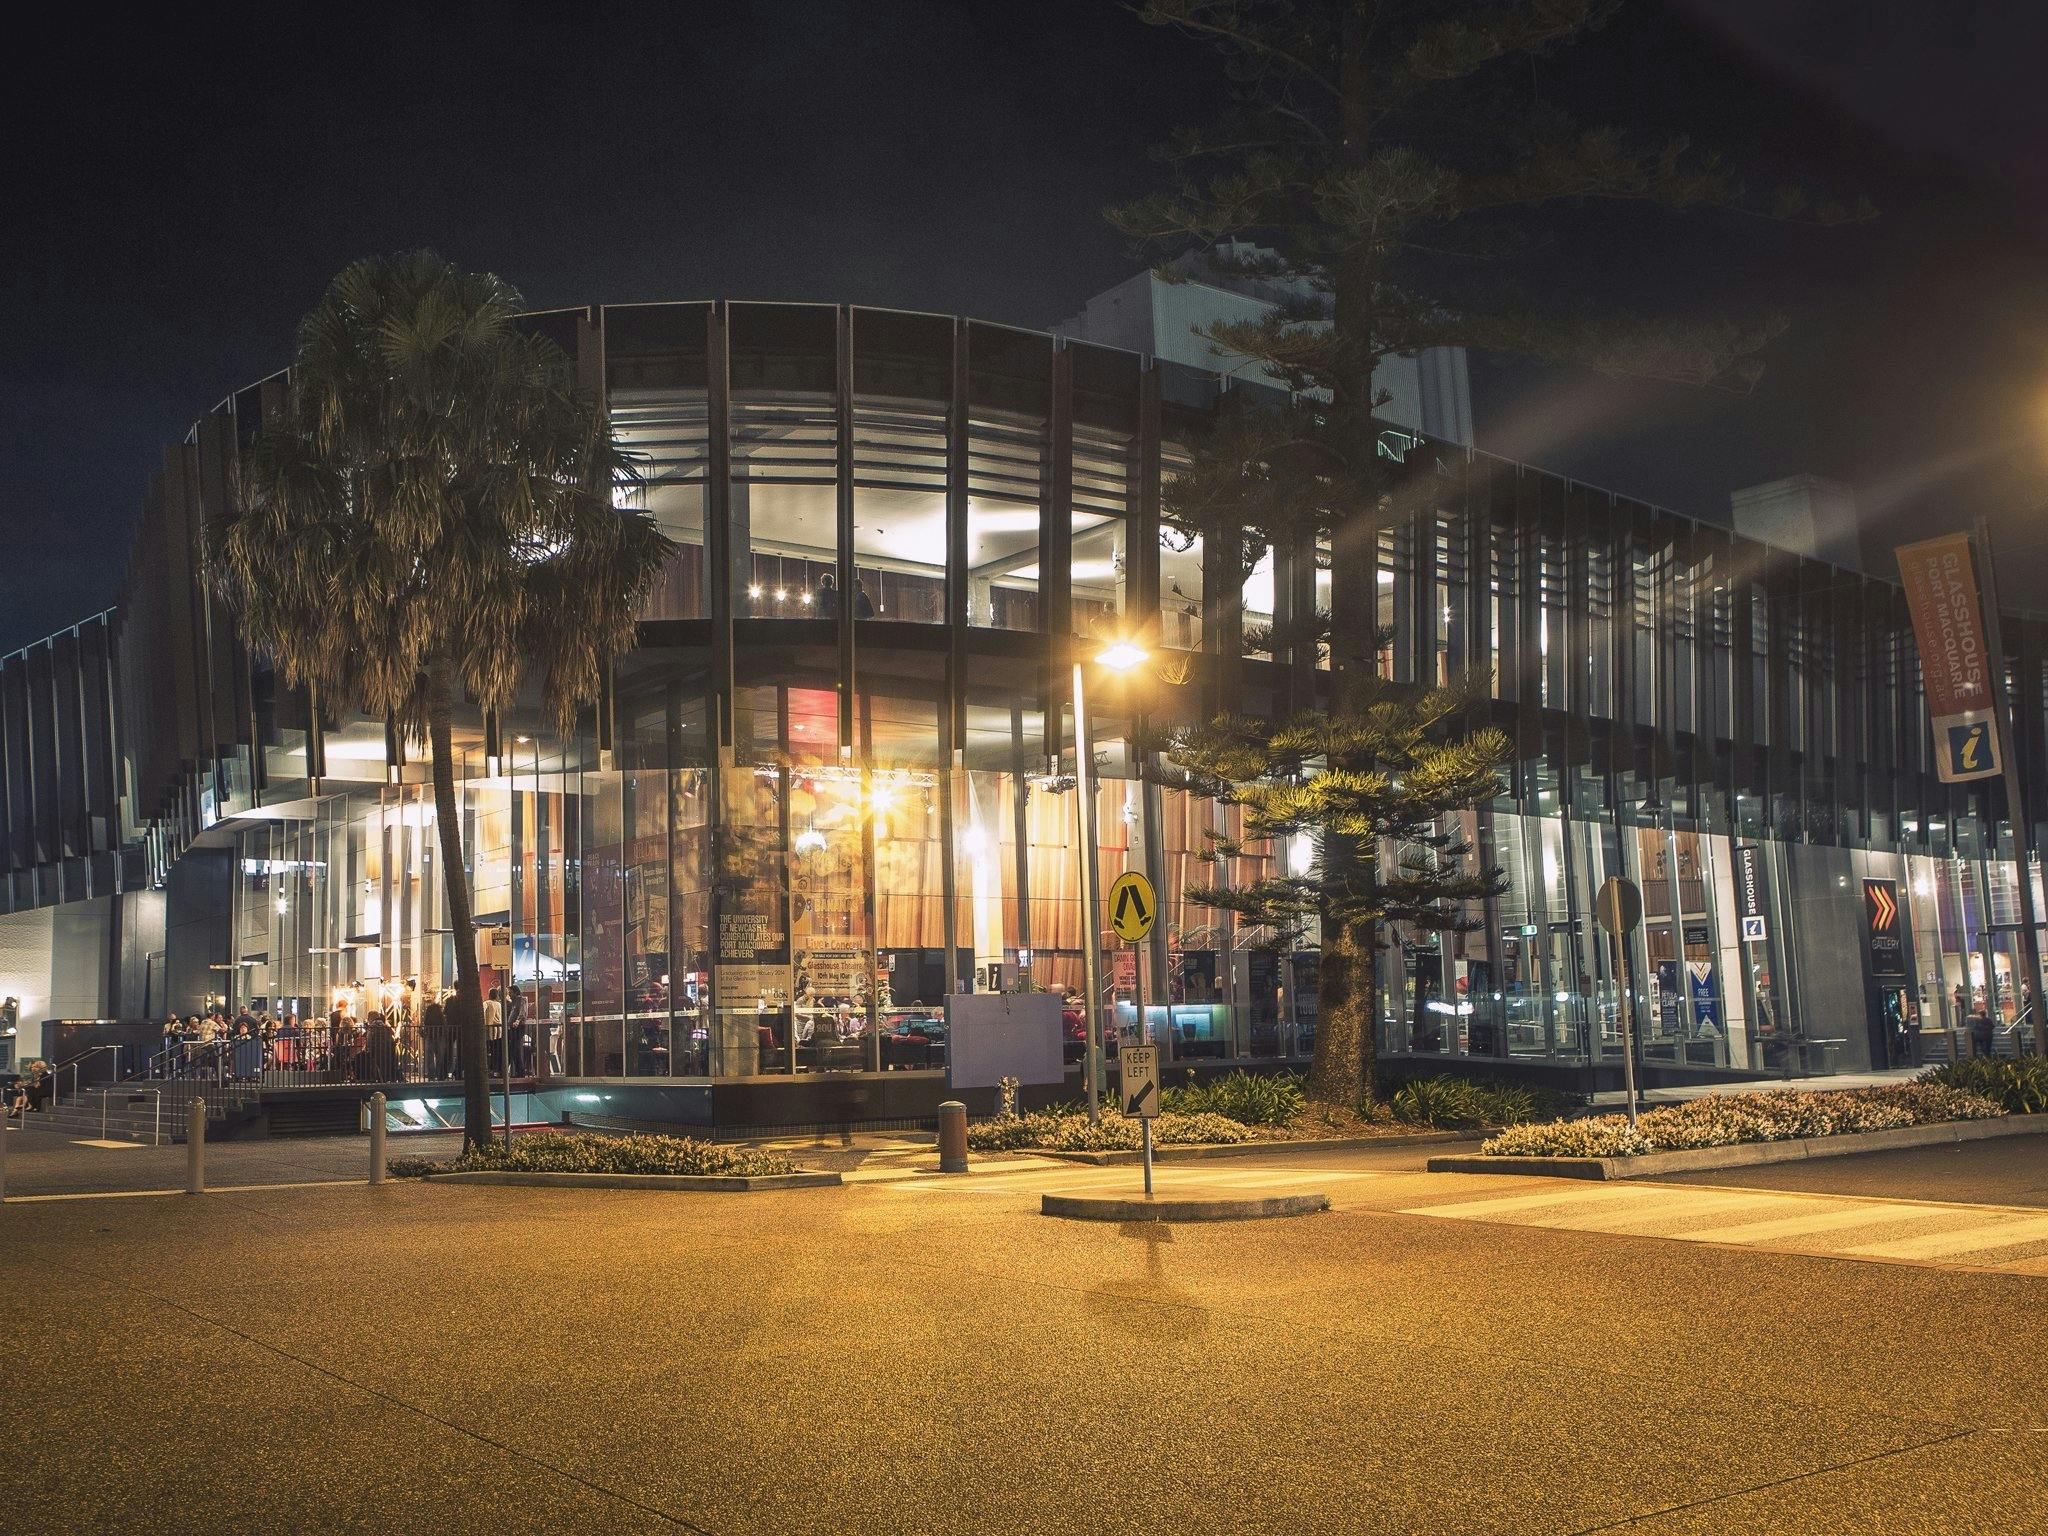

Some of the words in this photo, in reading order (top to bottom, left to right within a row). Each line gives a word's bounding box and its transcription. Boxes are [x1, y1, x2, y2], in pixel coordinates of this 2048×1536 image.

[1926, 556, 1944, 599] PORT
[1937, 602, 1967, 699] MACQUARIE
[1942, 552, 1983, 697] GLASSHOUSE
[1743, 849, 1756, 915] GLASSHOUSE
[720, 915, 731, 923] THE
[733, 915, 769, 923] UNIVERSITY
[720, 924, 729, 932] OF
[730, 924, 767, 932] NEWCASTLE
[720, 933, 771, 941] CONGRATULATES
[772, 933, 785, 941] OUR
[720, 941, 737, 949] PORT
[739, 941, 774, 949] MACQUARIE
[1872, 939, 1900, 950] GALLERY
[721, 950, 754, 958] ACHIEVERS
[808, 961, 839, 969] Glasshouse
[1127, 1053, 1150, 1063] KEEP
[1128, 1067, 1149, 1077] LEFT
